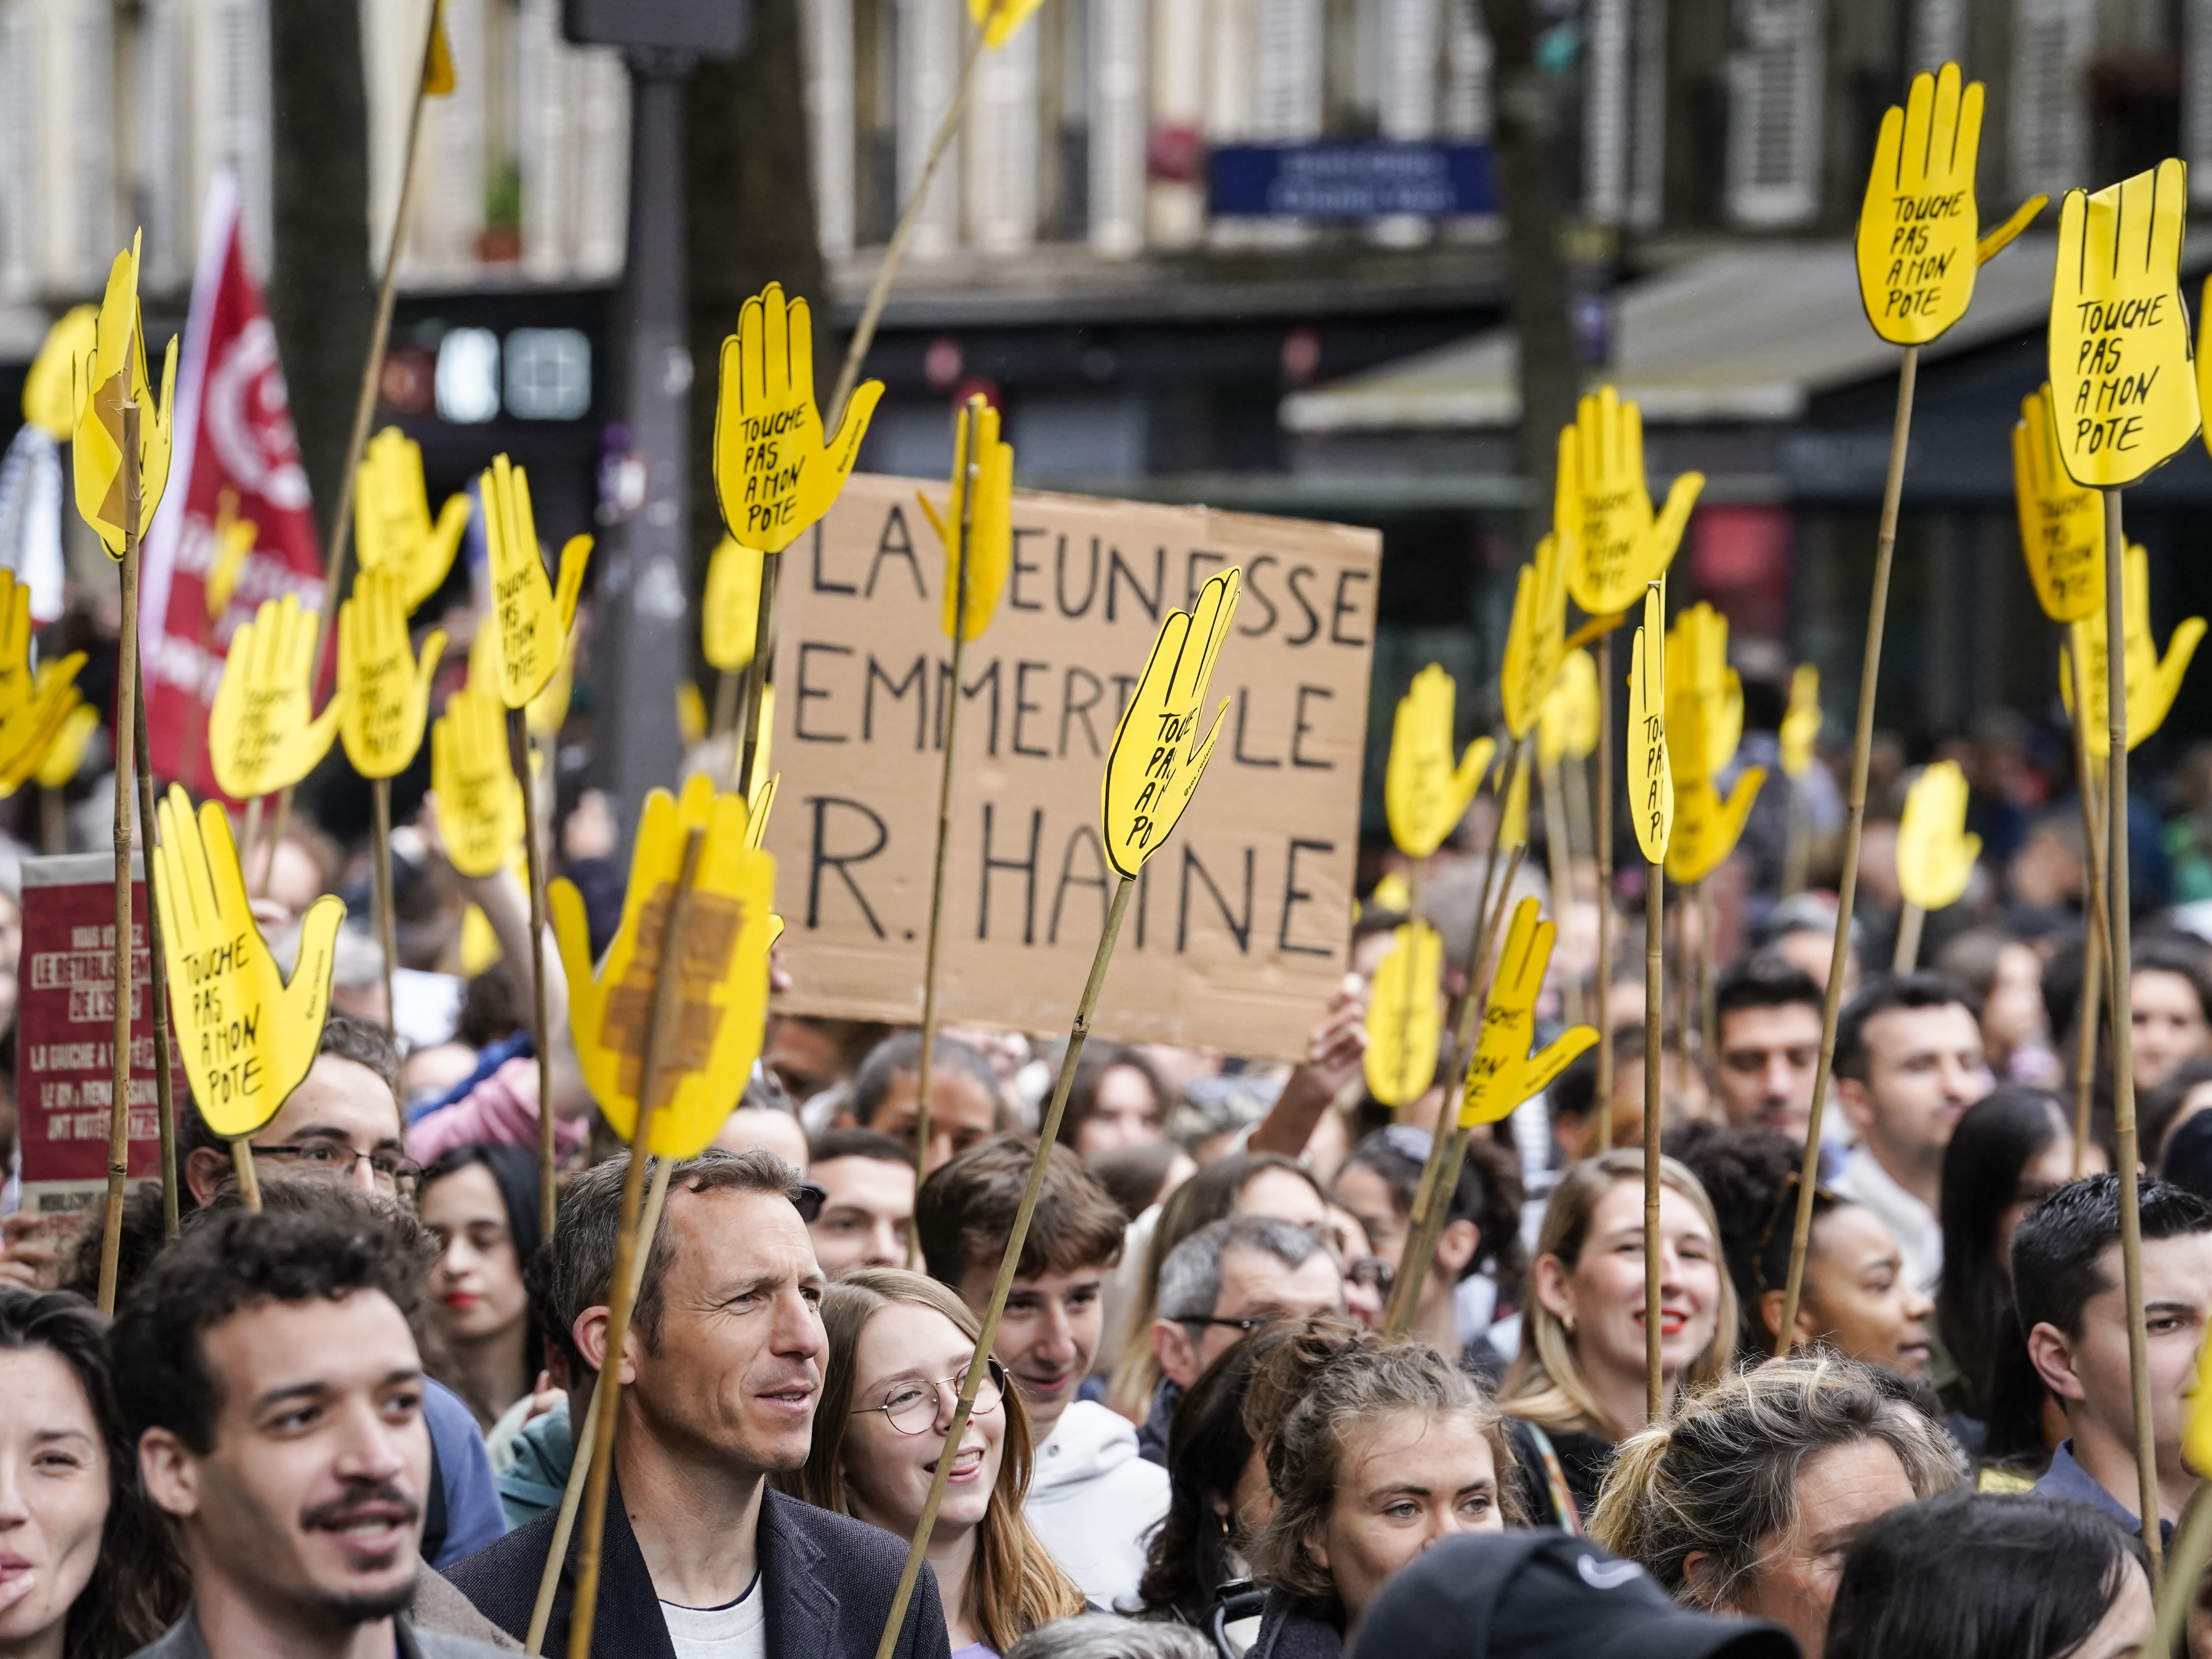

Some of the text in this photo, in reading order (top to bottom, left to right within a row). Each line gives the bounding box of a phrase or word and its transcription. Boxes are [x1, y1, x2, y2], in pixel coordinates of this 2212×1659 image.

[1892, 190, 1966, 222] TOUCHE
[1890, 225, 1930, 256] PAS
[1886, 246, 1957, 286] A MON
[1885, 286, 1941, 318] POTE
[2077, 294, 2168, 334] TOUCHE
[2076, 337, 2123, 375] PAS
[2075, 365, 2160, 415] A MON
[740, 402, 807, 443] TOUCHE
[2075, 416, 2144, 455] POTE
[744, 441, 778, 474] PAS
[745, 455, 807, 503] A MON
[748, 494, 797, 533] POTE
[812, 503, 928, 598] LA
[1233, 684, 1336, 770] LE
[1184, 740, 1215, 796] @sos_racisme
[1647, 742, 1664, 778] PA
[1134, 781, 1156, 813] A
[1648, 779, 1657, 810] A
[1126, 815, 1153, 849] PO
[802, 795, 1336, 956] R. HAINE
[182, 932, 250, 987] TOUCHE
[192, 985, 223, 1029] PAS
[201, 1031, 212, 1068] A
[216, 1002, 261, 1064] MON
[207, 1056, 264, 1107] POTE
